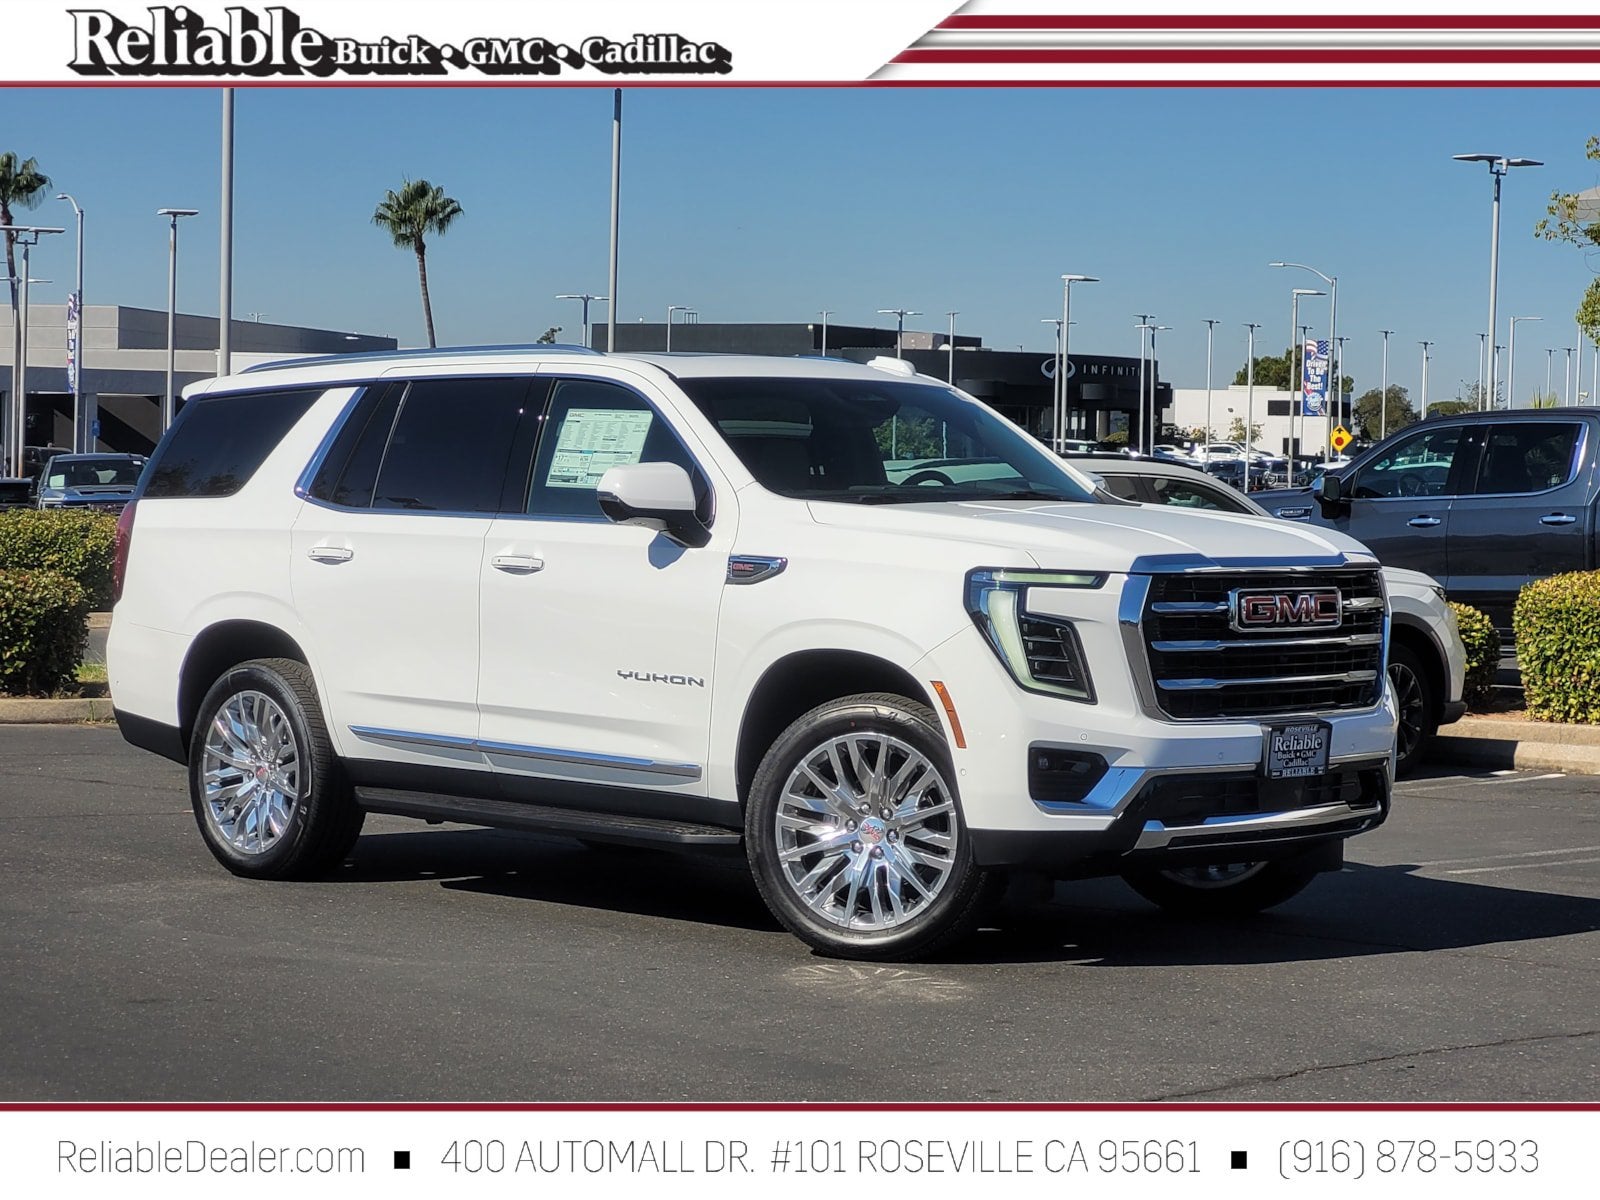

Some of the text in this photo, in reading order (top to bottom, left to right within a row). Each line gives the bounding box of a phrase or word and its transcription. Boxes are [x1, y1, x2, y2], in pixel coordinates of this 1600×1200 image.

[1082, 364, 1141, 377] INFINITI
[732, 563, 754, 571] GMC
[1241, 594, 1339, 624] GMC
[616, 669, 705, 688] YUKON
[1285, 724, 1319, 733] ROSEVILLE
[1274, 733, 1322, 752] Reliable
[1277, 752, 1296, 760] Buick
[1283, 759, 1309, 767] Cadillac
[1282, 767, 1316, 777] RELIABLE
